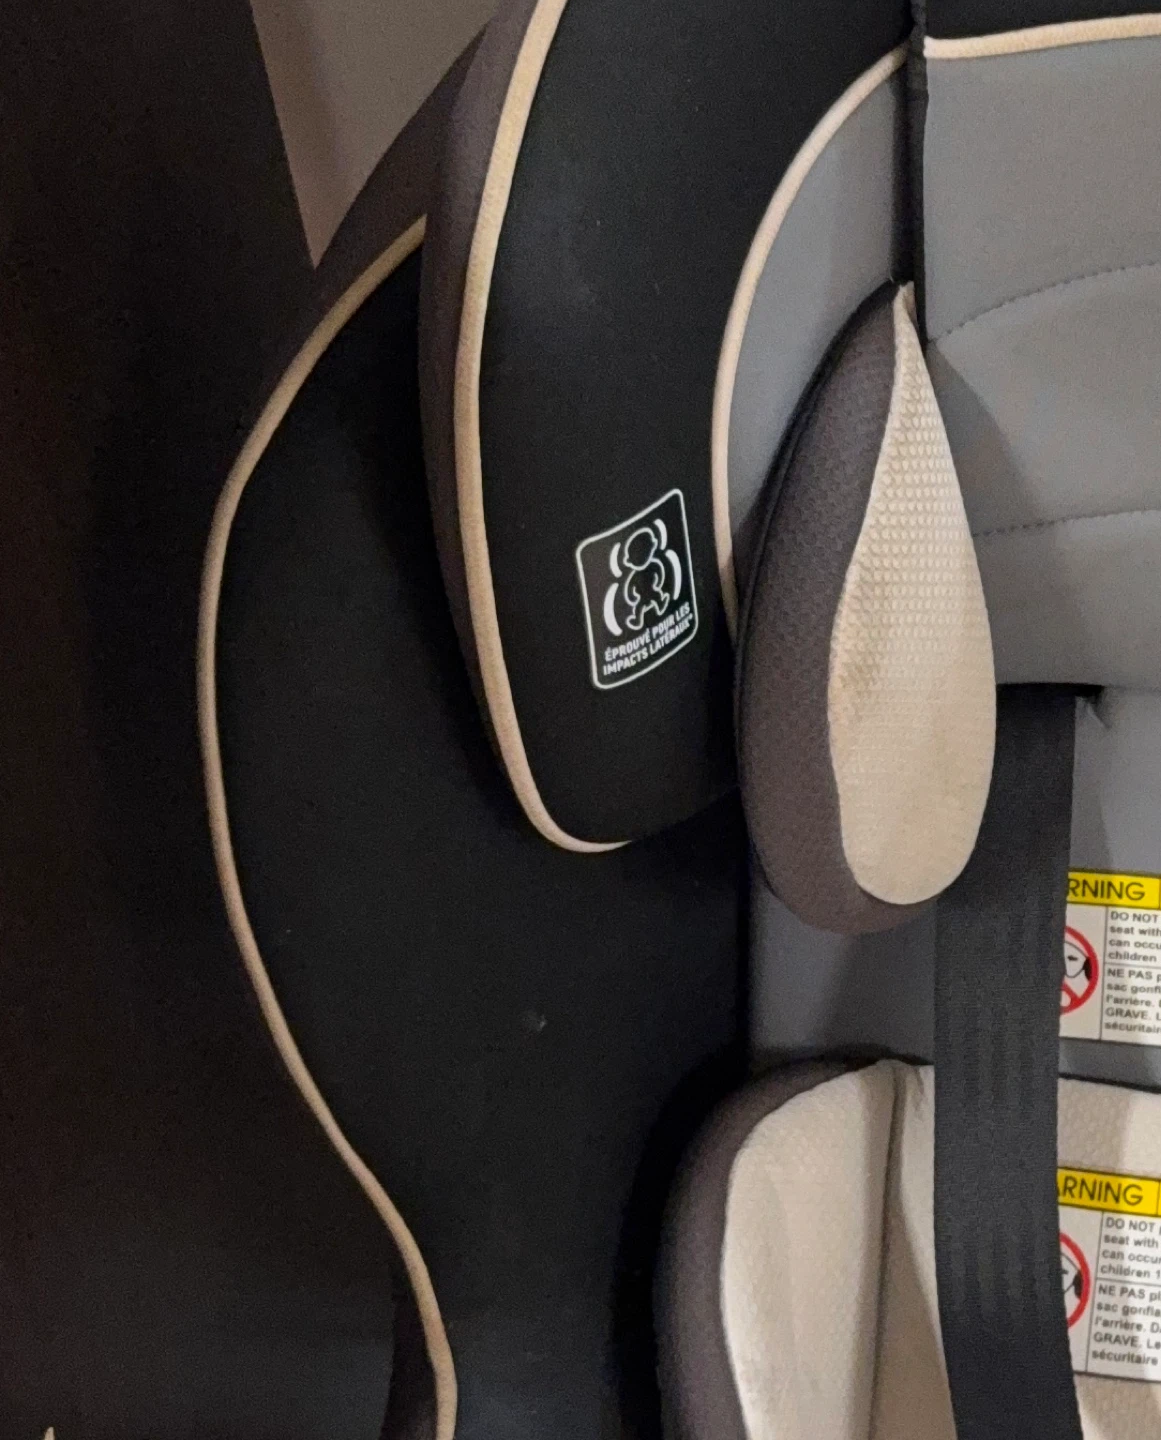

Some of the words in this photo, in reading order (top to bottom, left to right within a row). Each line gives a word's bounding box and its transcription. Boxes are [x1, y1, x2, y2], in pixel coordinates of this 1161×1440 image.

[605, 628, 650, 661] ÉPROUVÉ
[652, 614, 675, 639] POUR
[676, 601, 690, 621] LES
[603, 647, 649, 675] IMPACTS
[1111, 911, 1128, 921] DO
[1133, 913, 1158, 923] NOT
[1110, 926, 1134, 934] seat
[1109, 939, 1130, 947] can
[1108, 951, 1156, 962] children
[1107, 968, 1124, 978] NE
[1129, 970, 1152, 980] PAS
[1106, 983, 1128, 992] sac
[1058, 1176, 1143, 1206] RNING
[1106, 1217, 1124, 1228] DO
[1129, 1220, 1155, 1232] NOT
[1104, 1233, 1129, 1244] seat
[1134, 1238, 1158, 1248] with
[1102, 1249, 1124, 1260] can
[1100, 1263, 1151, 1278] children
[1098, 1285, 1116, 1296] NE
[1120, 1288, 1145, 1299] PAS
[1097, 1302, 1118, 1311] sac
[1147, 1339, 1161, 1350] Le
[1092, 1349, 1158, 1366] sécuritaire
